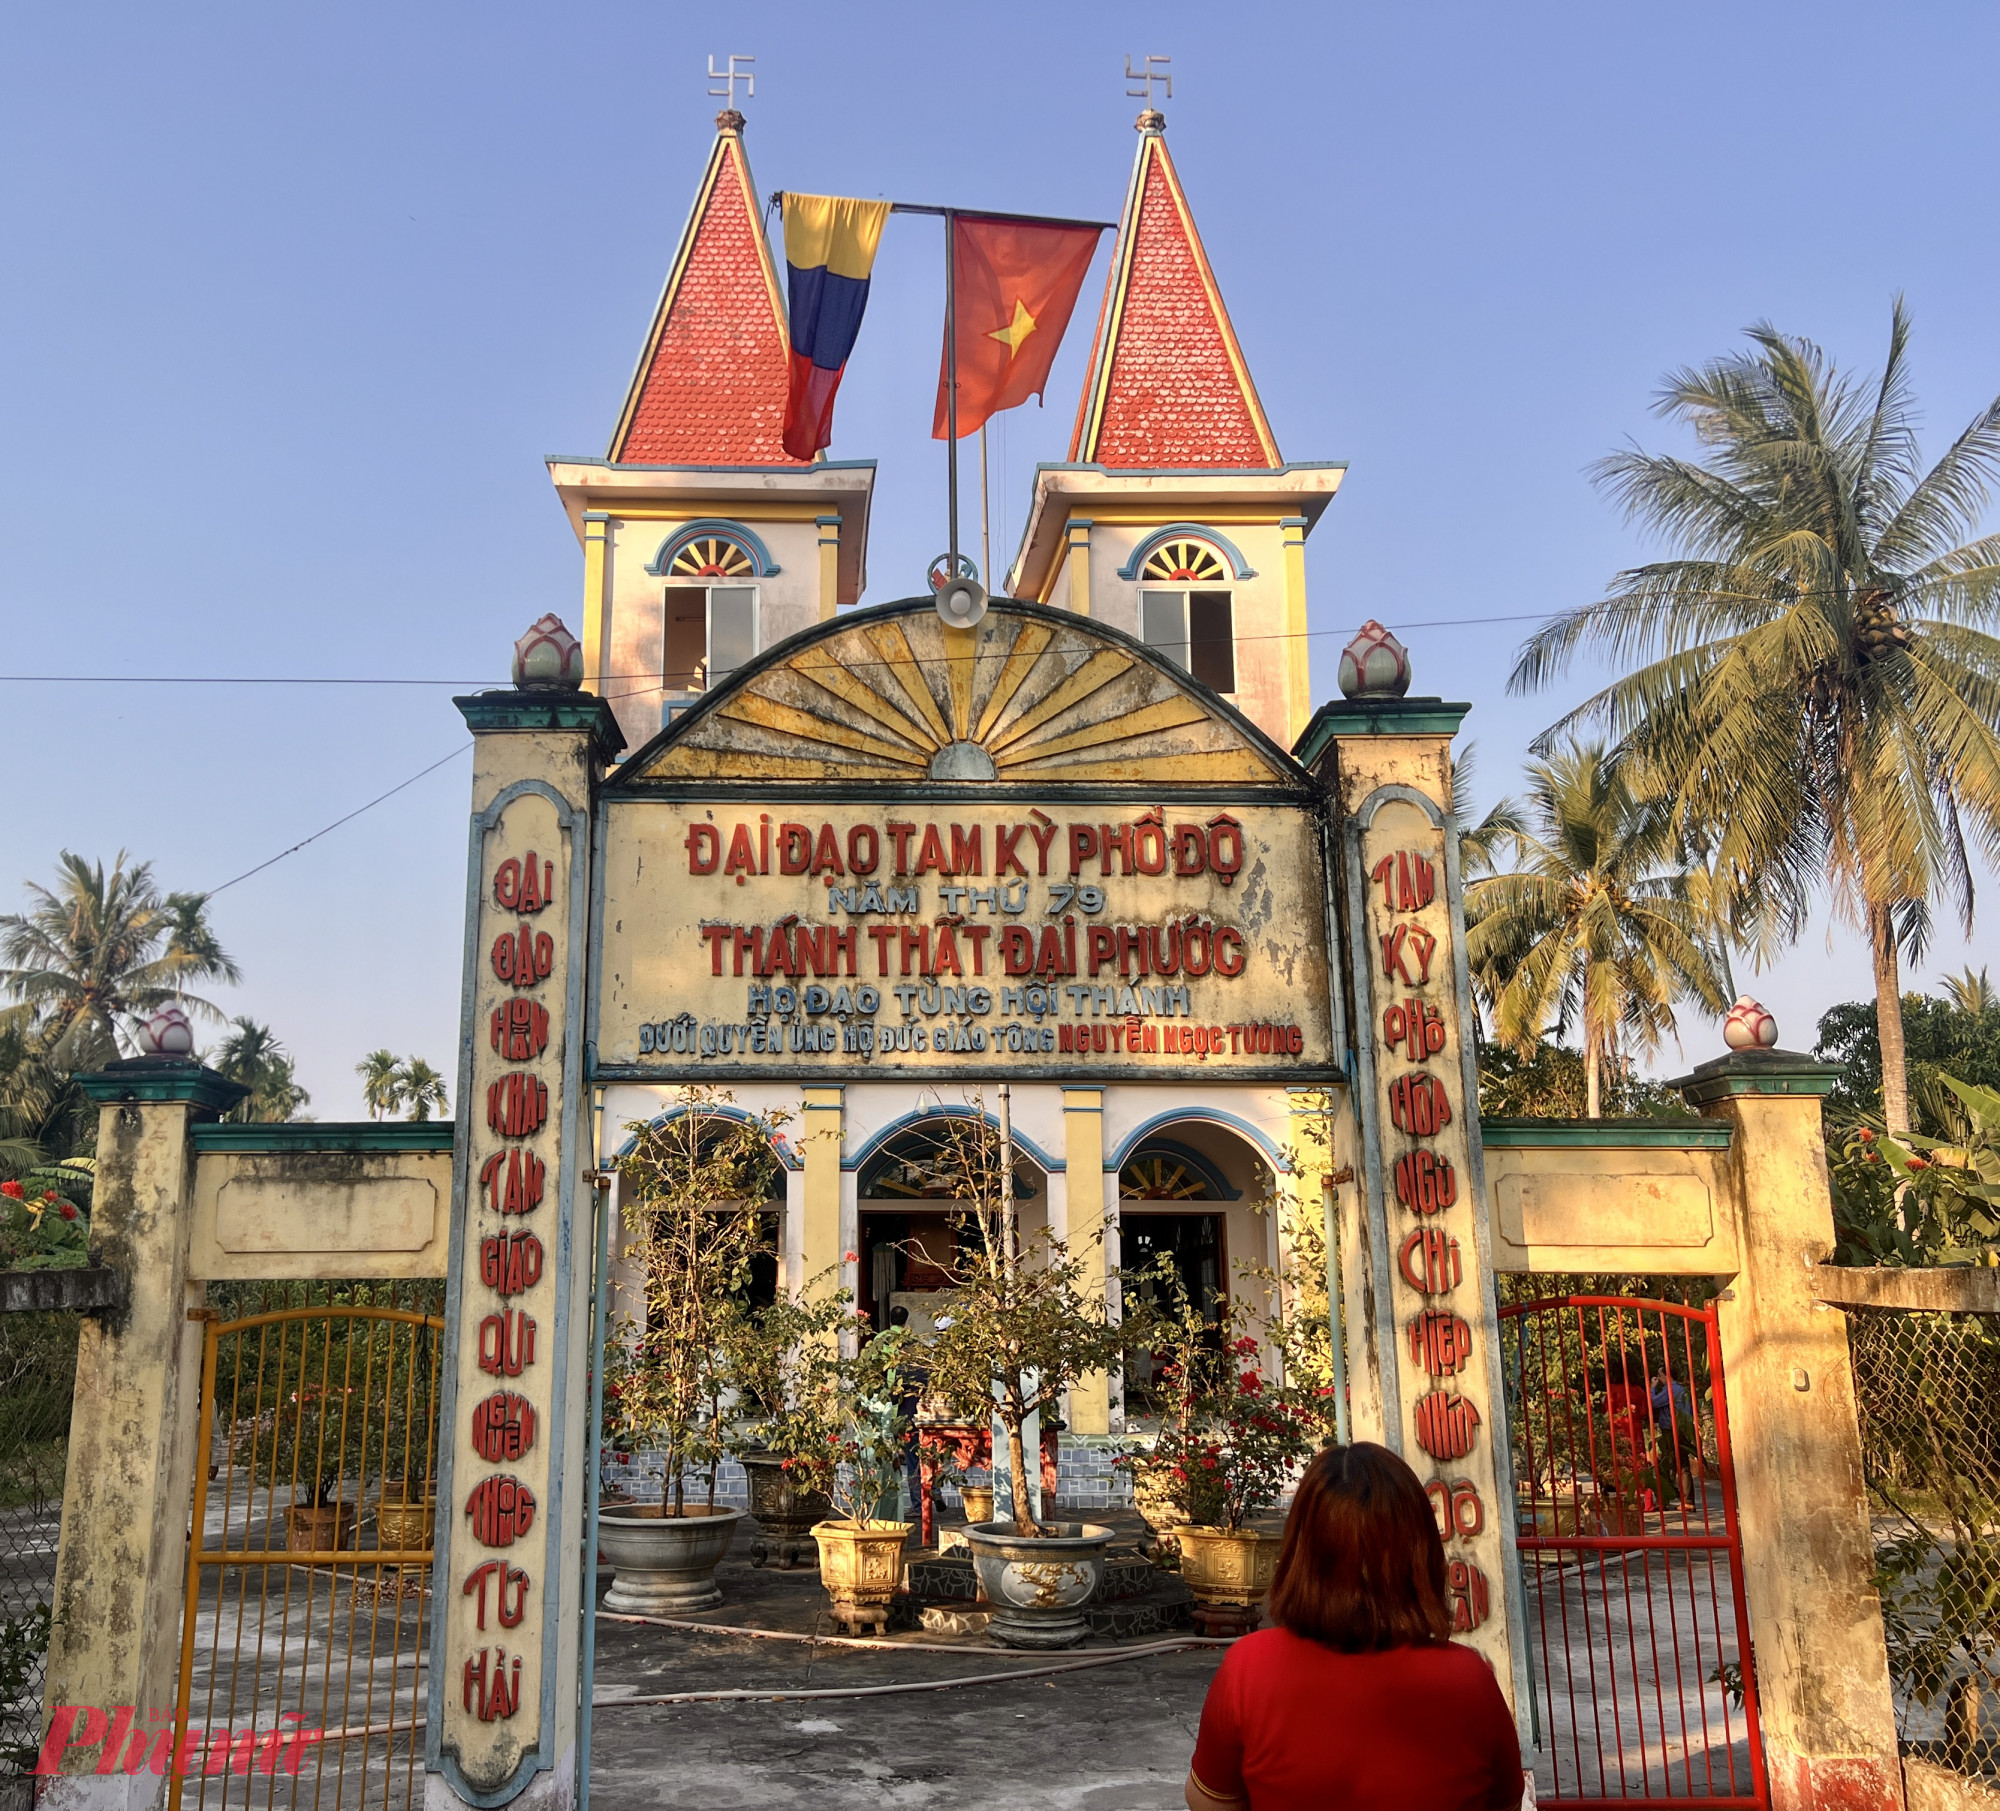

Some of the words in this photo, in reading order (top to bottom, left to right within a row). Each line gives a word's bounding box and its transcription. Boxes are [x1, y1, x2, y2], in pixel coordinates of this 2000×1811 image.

[684, 813, 770, 886] ĐẠI
[776, 823, 880, 887] ĐẠO
[887, 823, 982, 877] TAM
[995, 807, 1059, 877] KỲ
[1069, 804, 1166, 876] PHỔ
[1169, 812, 1244, 886] ĐỘ
[494, 850, 553, 914] ĐẠI
[828, 880, 918, 914] NĂM
[939, 877, 1029, 915] THỨ
[1049, 884, 1105, 914] 79
[1374, 850, 1435, 913] TAM
[491, 923, 554, 986] ĐẠO
[702, 914, 857, 977] THÁNH
[868, 914, 991, 977] THẤT
[999, 914, 1077, 983] ĐẠI
[1087, 914, 1244, 977] PHƯỚC
[1382, 923, 1436, 987] KỲ
[747, 984, 797, 1023] HỌ
[803, 984, 880, 1023] ĐẠO
[894, 976, 992, 1016] TÙNG
[1001, 979, 1058, 1023] HỘI
[1067, 976, 1191, 1017] THÁNH
[1385, 998, 1446, 1062] PHỔ
[639, 1012, 698, 1054] DƯỚI
[789, 1012, 836, 1053] ỦNG
[842, 1020, 875, 1060] HỘ
[880, 1016, 927, 1053] ĐỨC
[932, 1016, 986, 1053] GIÁO
[991, 1021, 1054, 1054] TÔNG
[1058, 1015, 1157, 1054] NGUYỄN
[1163, 1024, 1224, 1060] NGỌC
[1225, 1022, 1304, 1055] TƯƠNG
[487, 1072, 547, 1137] KHAI
[481, 1147, 544, 1214] TAM
[480, 1229, 543, 1296] GIÁO
[1401, 1228, 1462, 1294] CHI
[478, 1308, 536, 1378] QUI
[1408, 1308, 1471, 1377] HIỆP
[463, 1646, 523, 1722] HẢI
